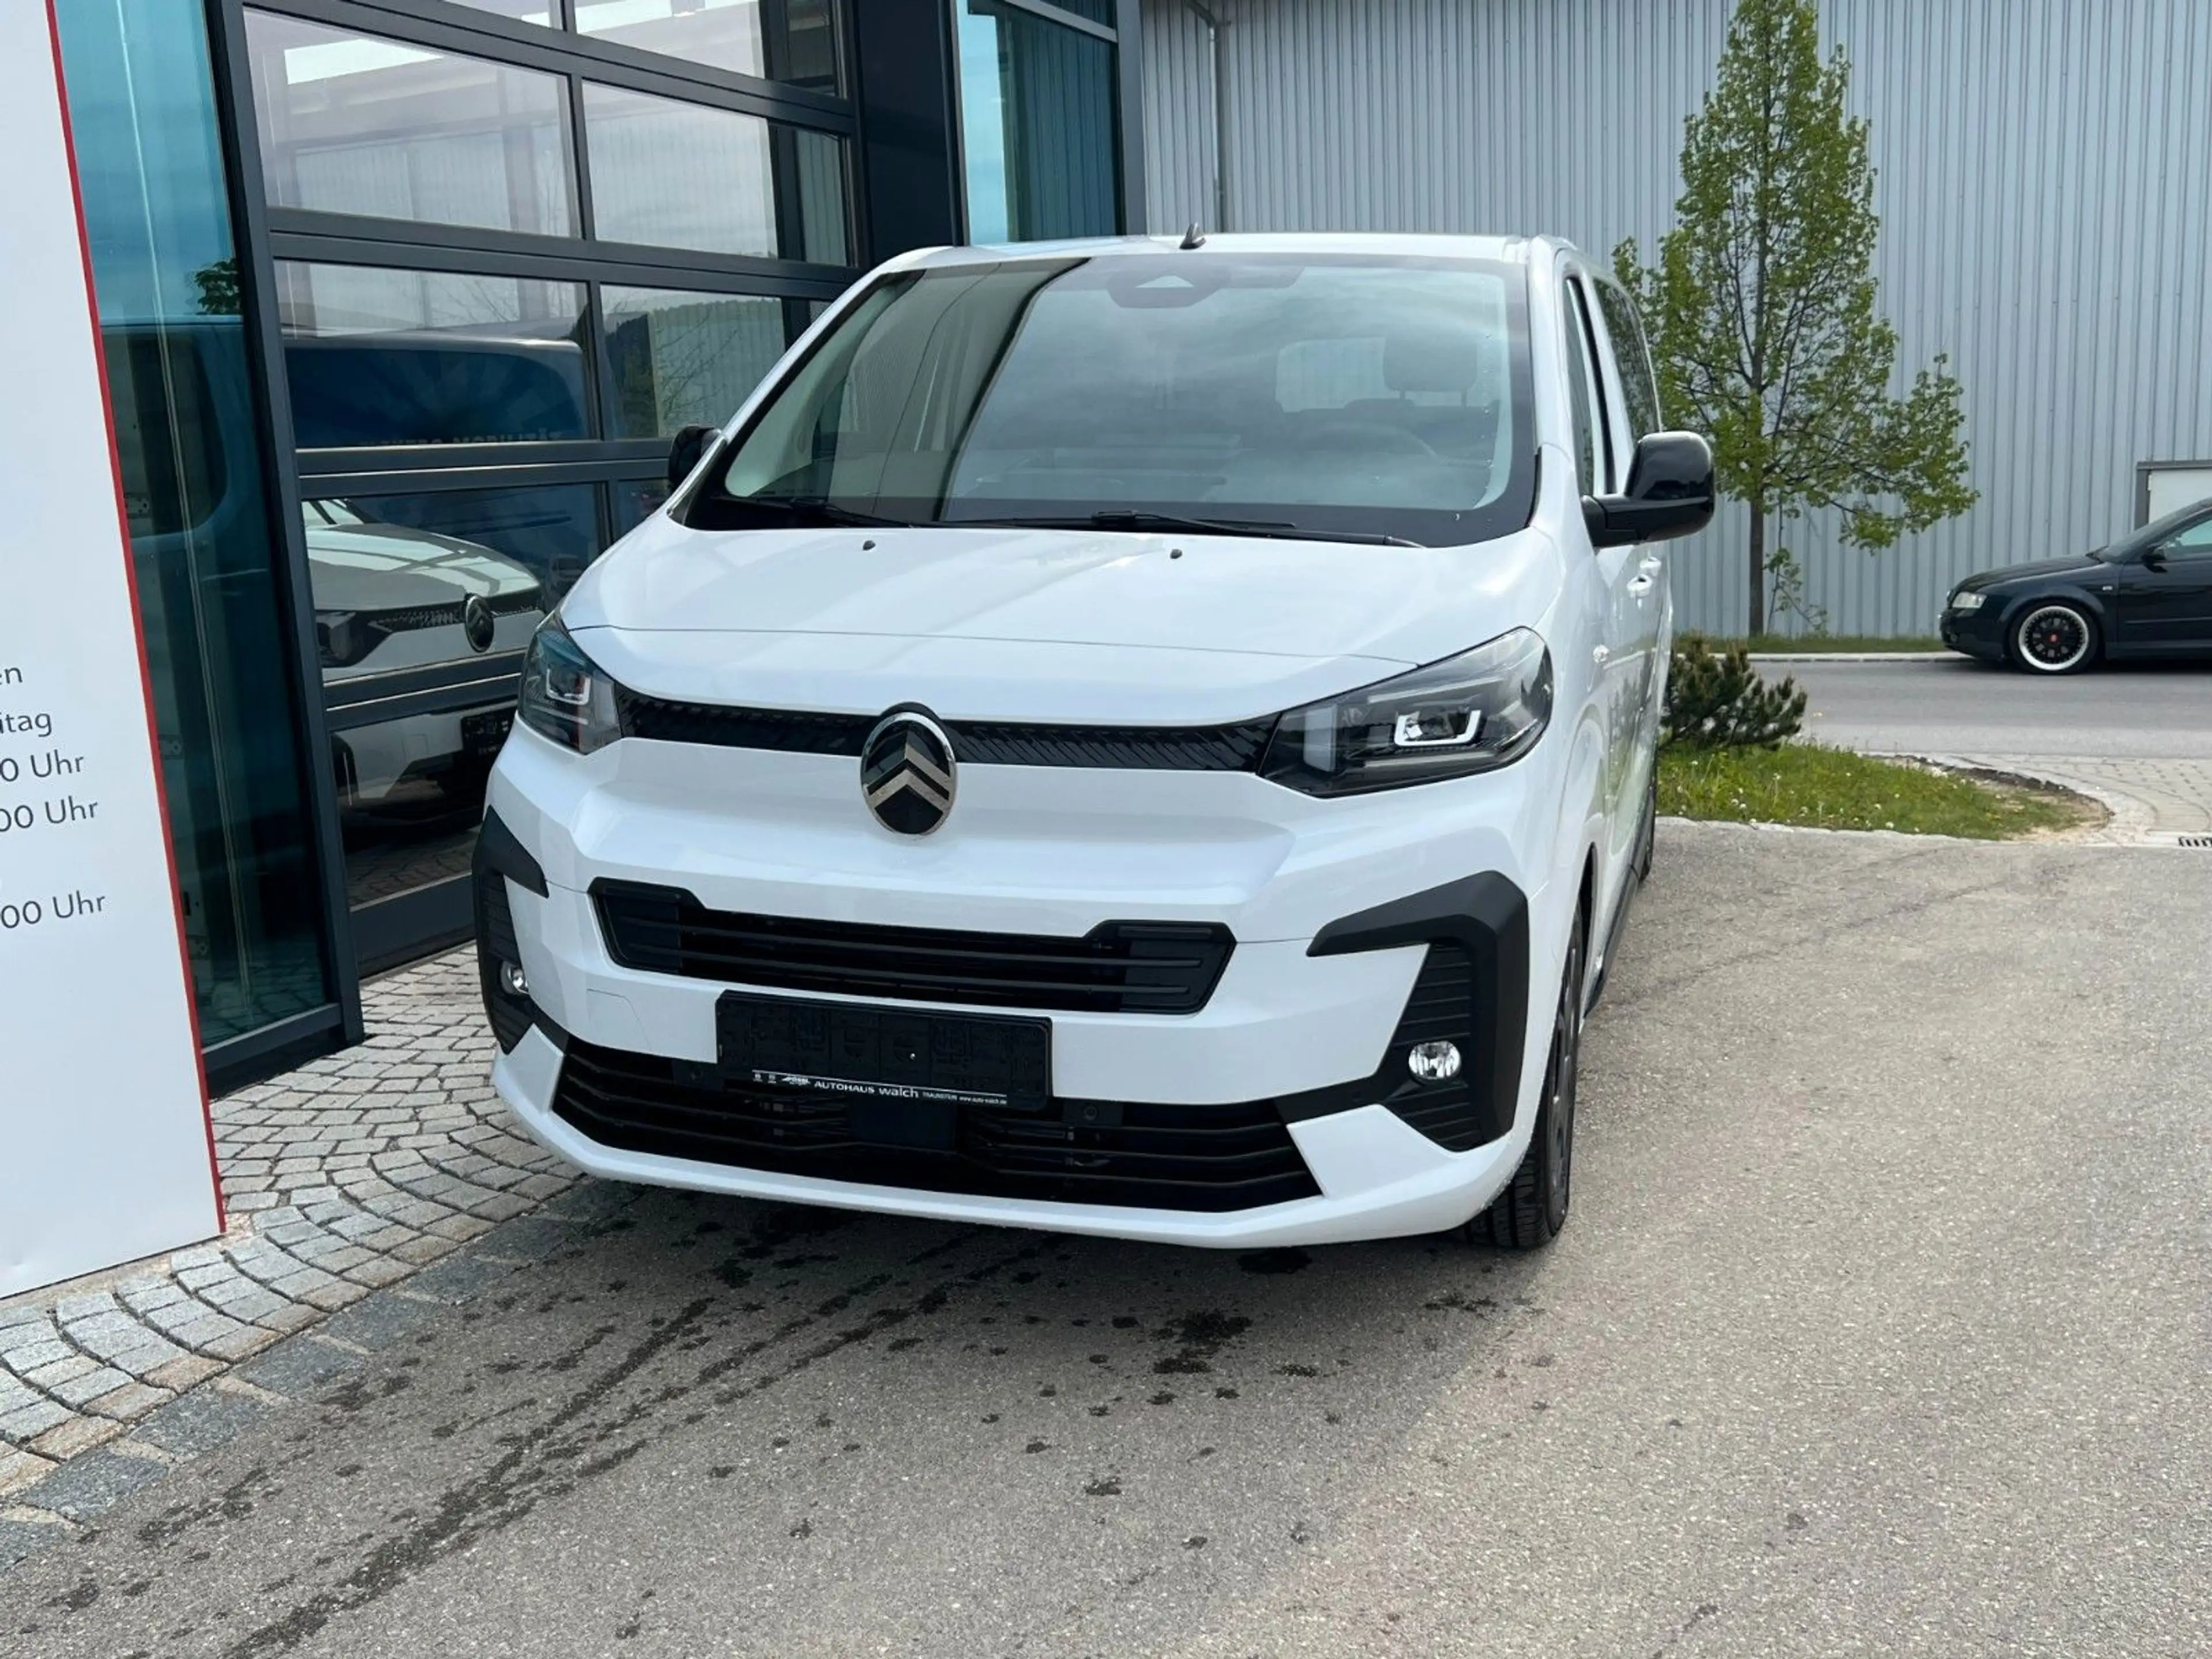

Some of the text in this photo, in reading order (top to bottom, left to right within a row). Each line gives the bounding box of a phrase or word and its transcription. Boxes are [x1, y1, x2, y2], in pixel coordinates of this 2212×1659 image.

[30, 749, 84, 778] Uhr
[44, 795, 99, 824] Uhr
[52, 890, 105, 919] Uhr
[814, 1080, 875, 1094] AUTOHAUS
[879, 1086, 919, 1099] walch
